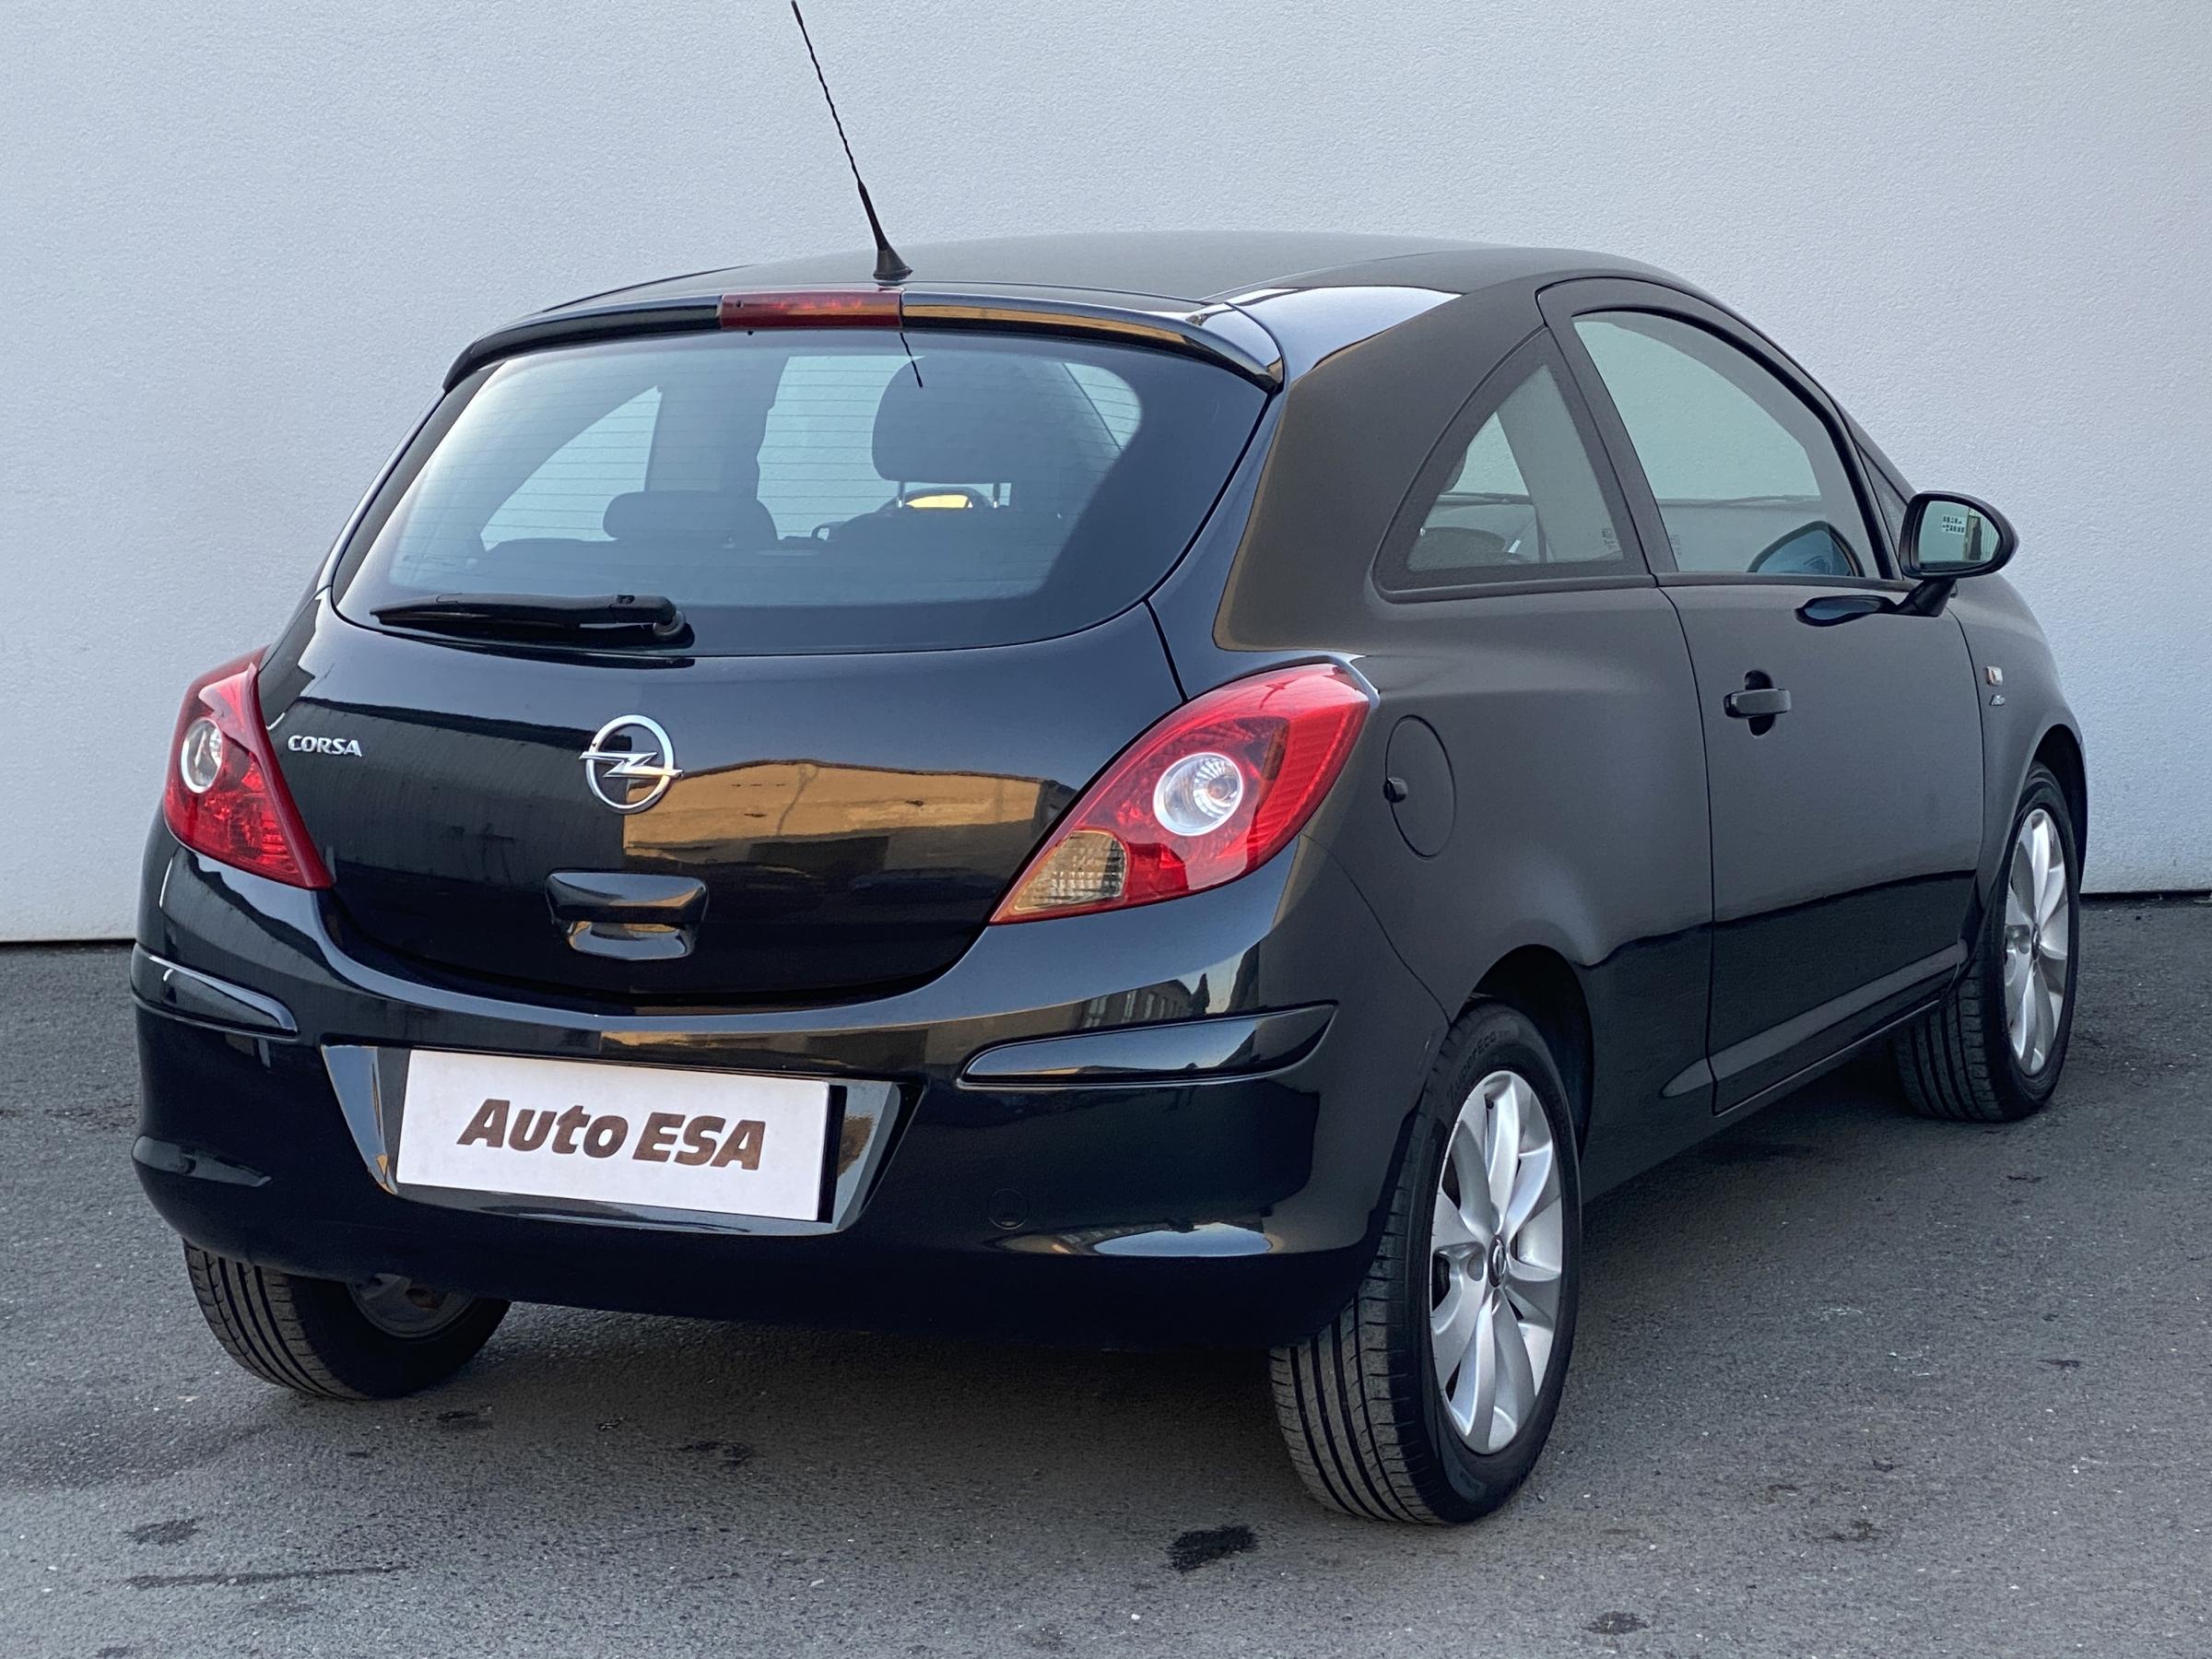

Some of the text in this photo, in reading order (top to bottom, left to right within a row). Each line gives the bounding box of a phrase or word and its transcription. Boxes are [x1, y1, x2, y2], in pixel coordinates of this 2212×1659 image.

[288, 735, 362, 757] CORSA
[456, 1099, 767, 1171] Auto ESA
